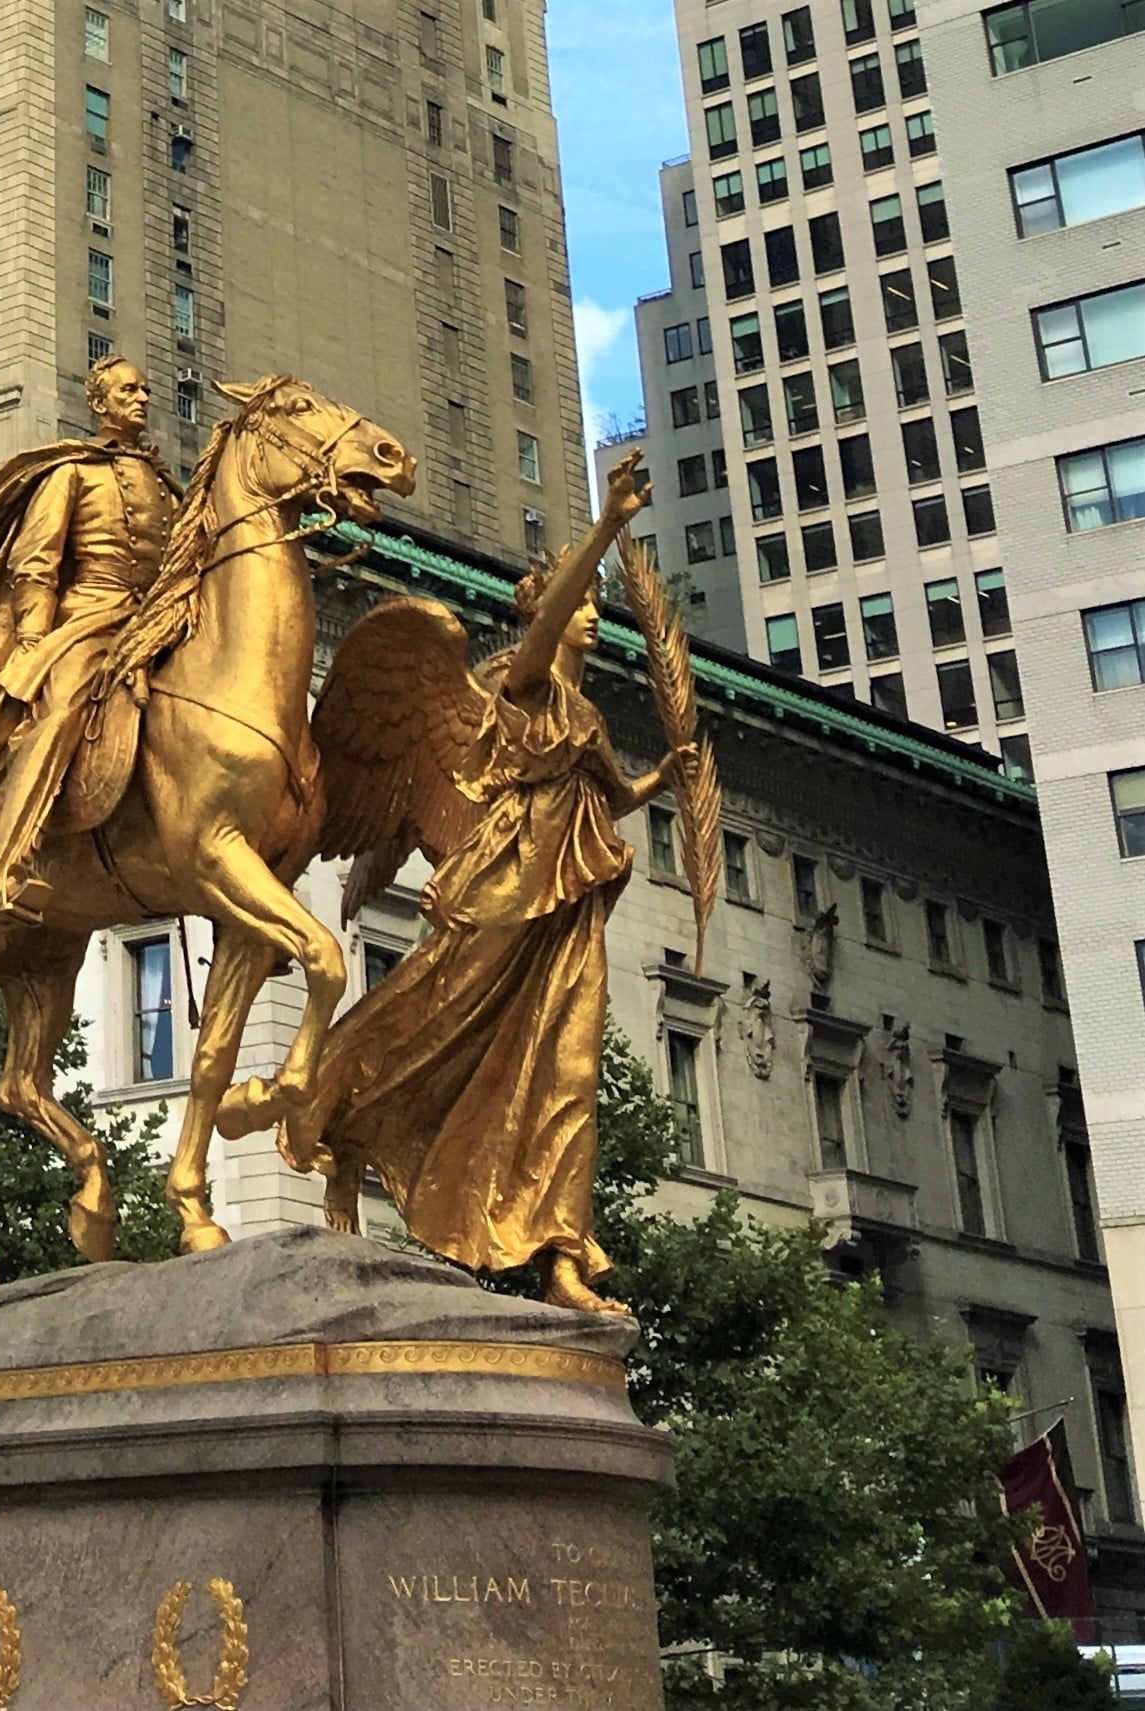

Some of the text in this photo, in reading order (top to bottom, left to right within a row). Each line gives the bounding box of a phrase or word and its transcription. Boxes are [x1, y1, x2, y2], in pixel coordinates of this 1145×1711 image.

[550, 1542, 582, 1564] TO
[388, 1575, 531, 1604] WILLIAM
[450, 1658, 543, 1678] ERECTED
[551, 1661, 572, 1679] BY
